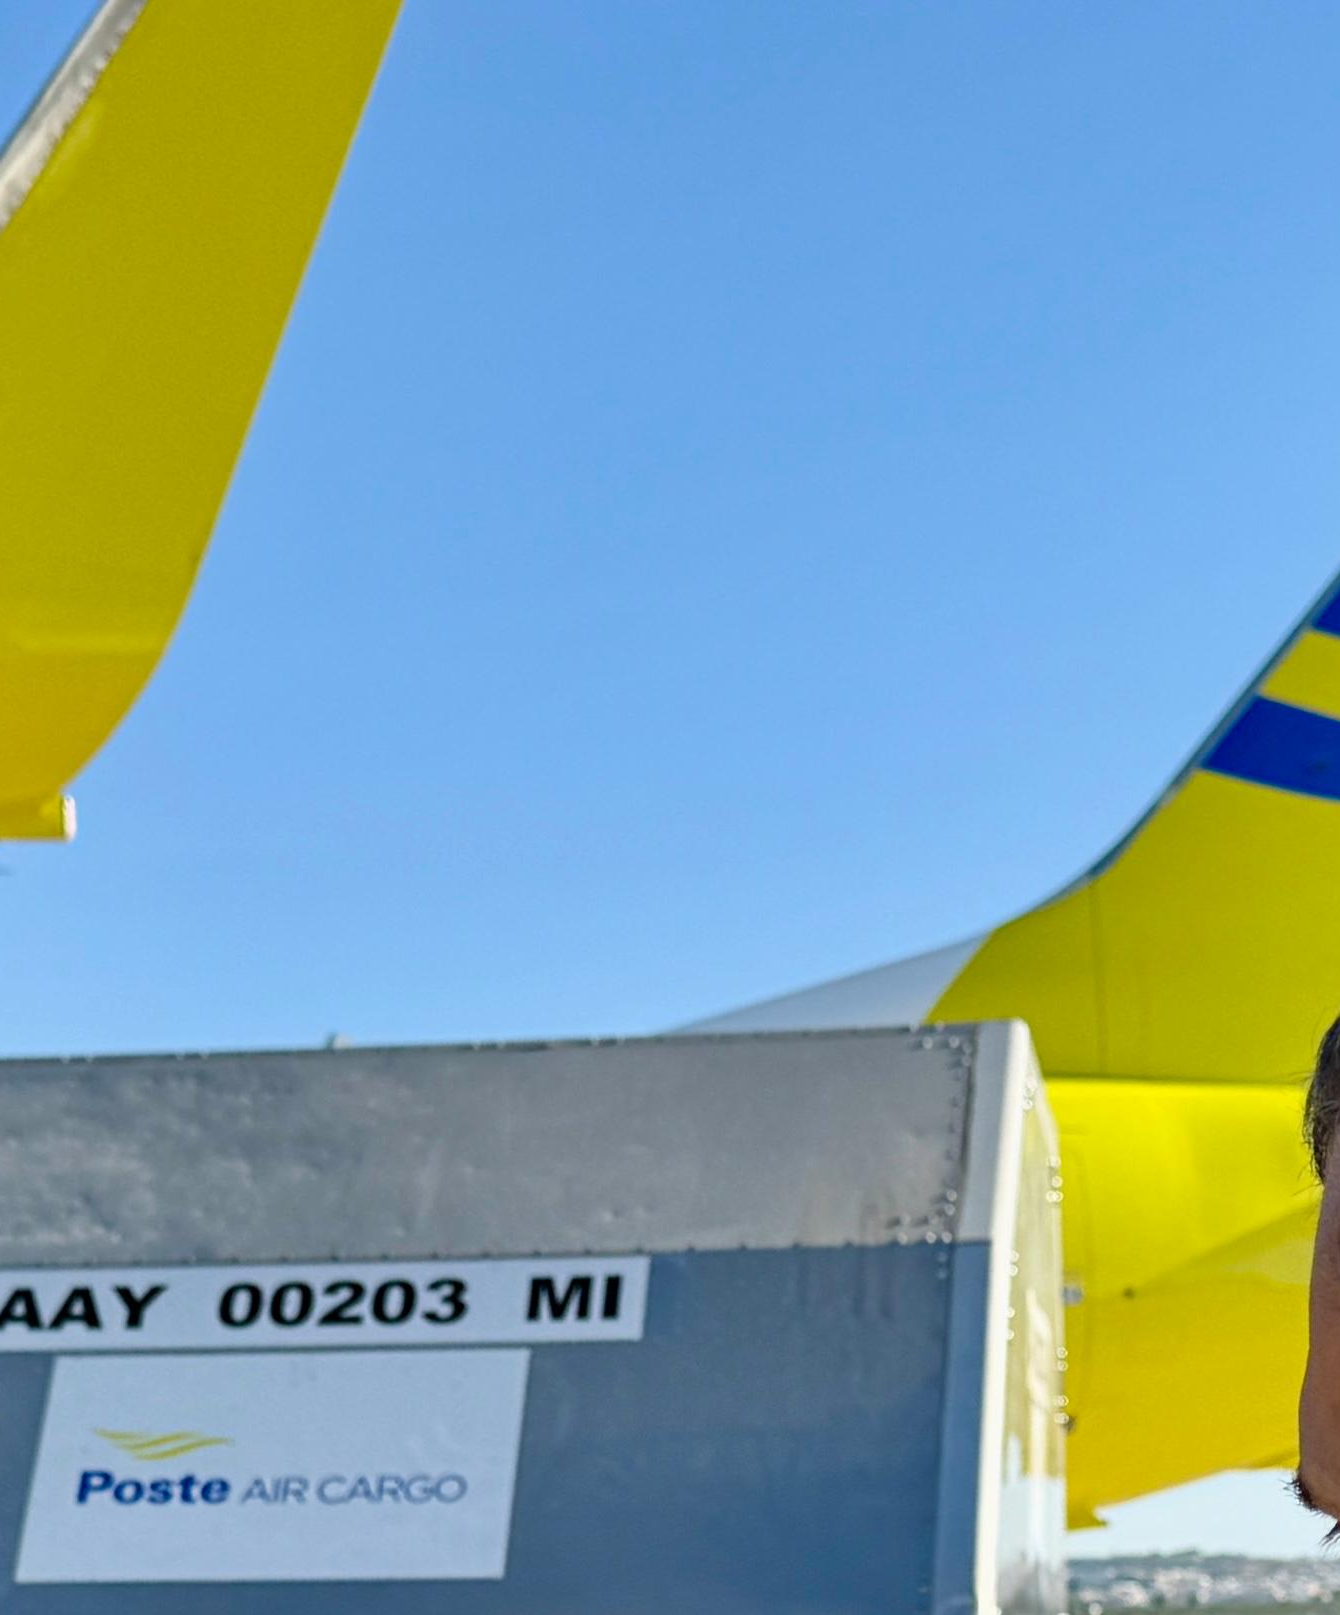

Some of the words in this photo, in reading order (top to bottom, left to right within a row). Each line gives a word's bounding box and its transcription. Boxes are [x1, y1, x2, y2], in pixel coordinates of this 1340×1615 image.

[219, 1278, 467, 1328] 00203
[527, 1275, 622, 1321] MI
[77, 1471, 230, 1504] Poste
[241, 1477, 309, 1503] AIR
[316, 1474, 468, 1505] CARGO
